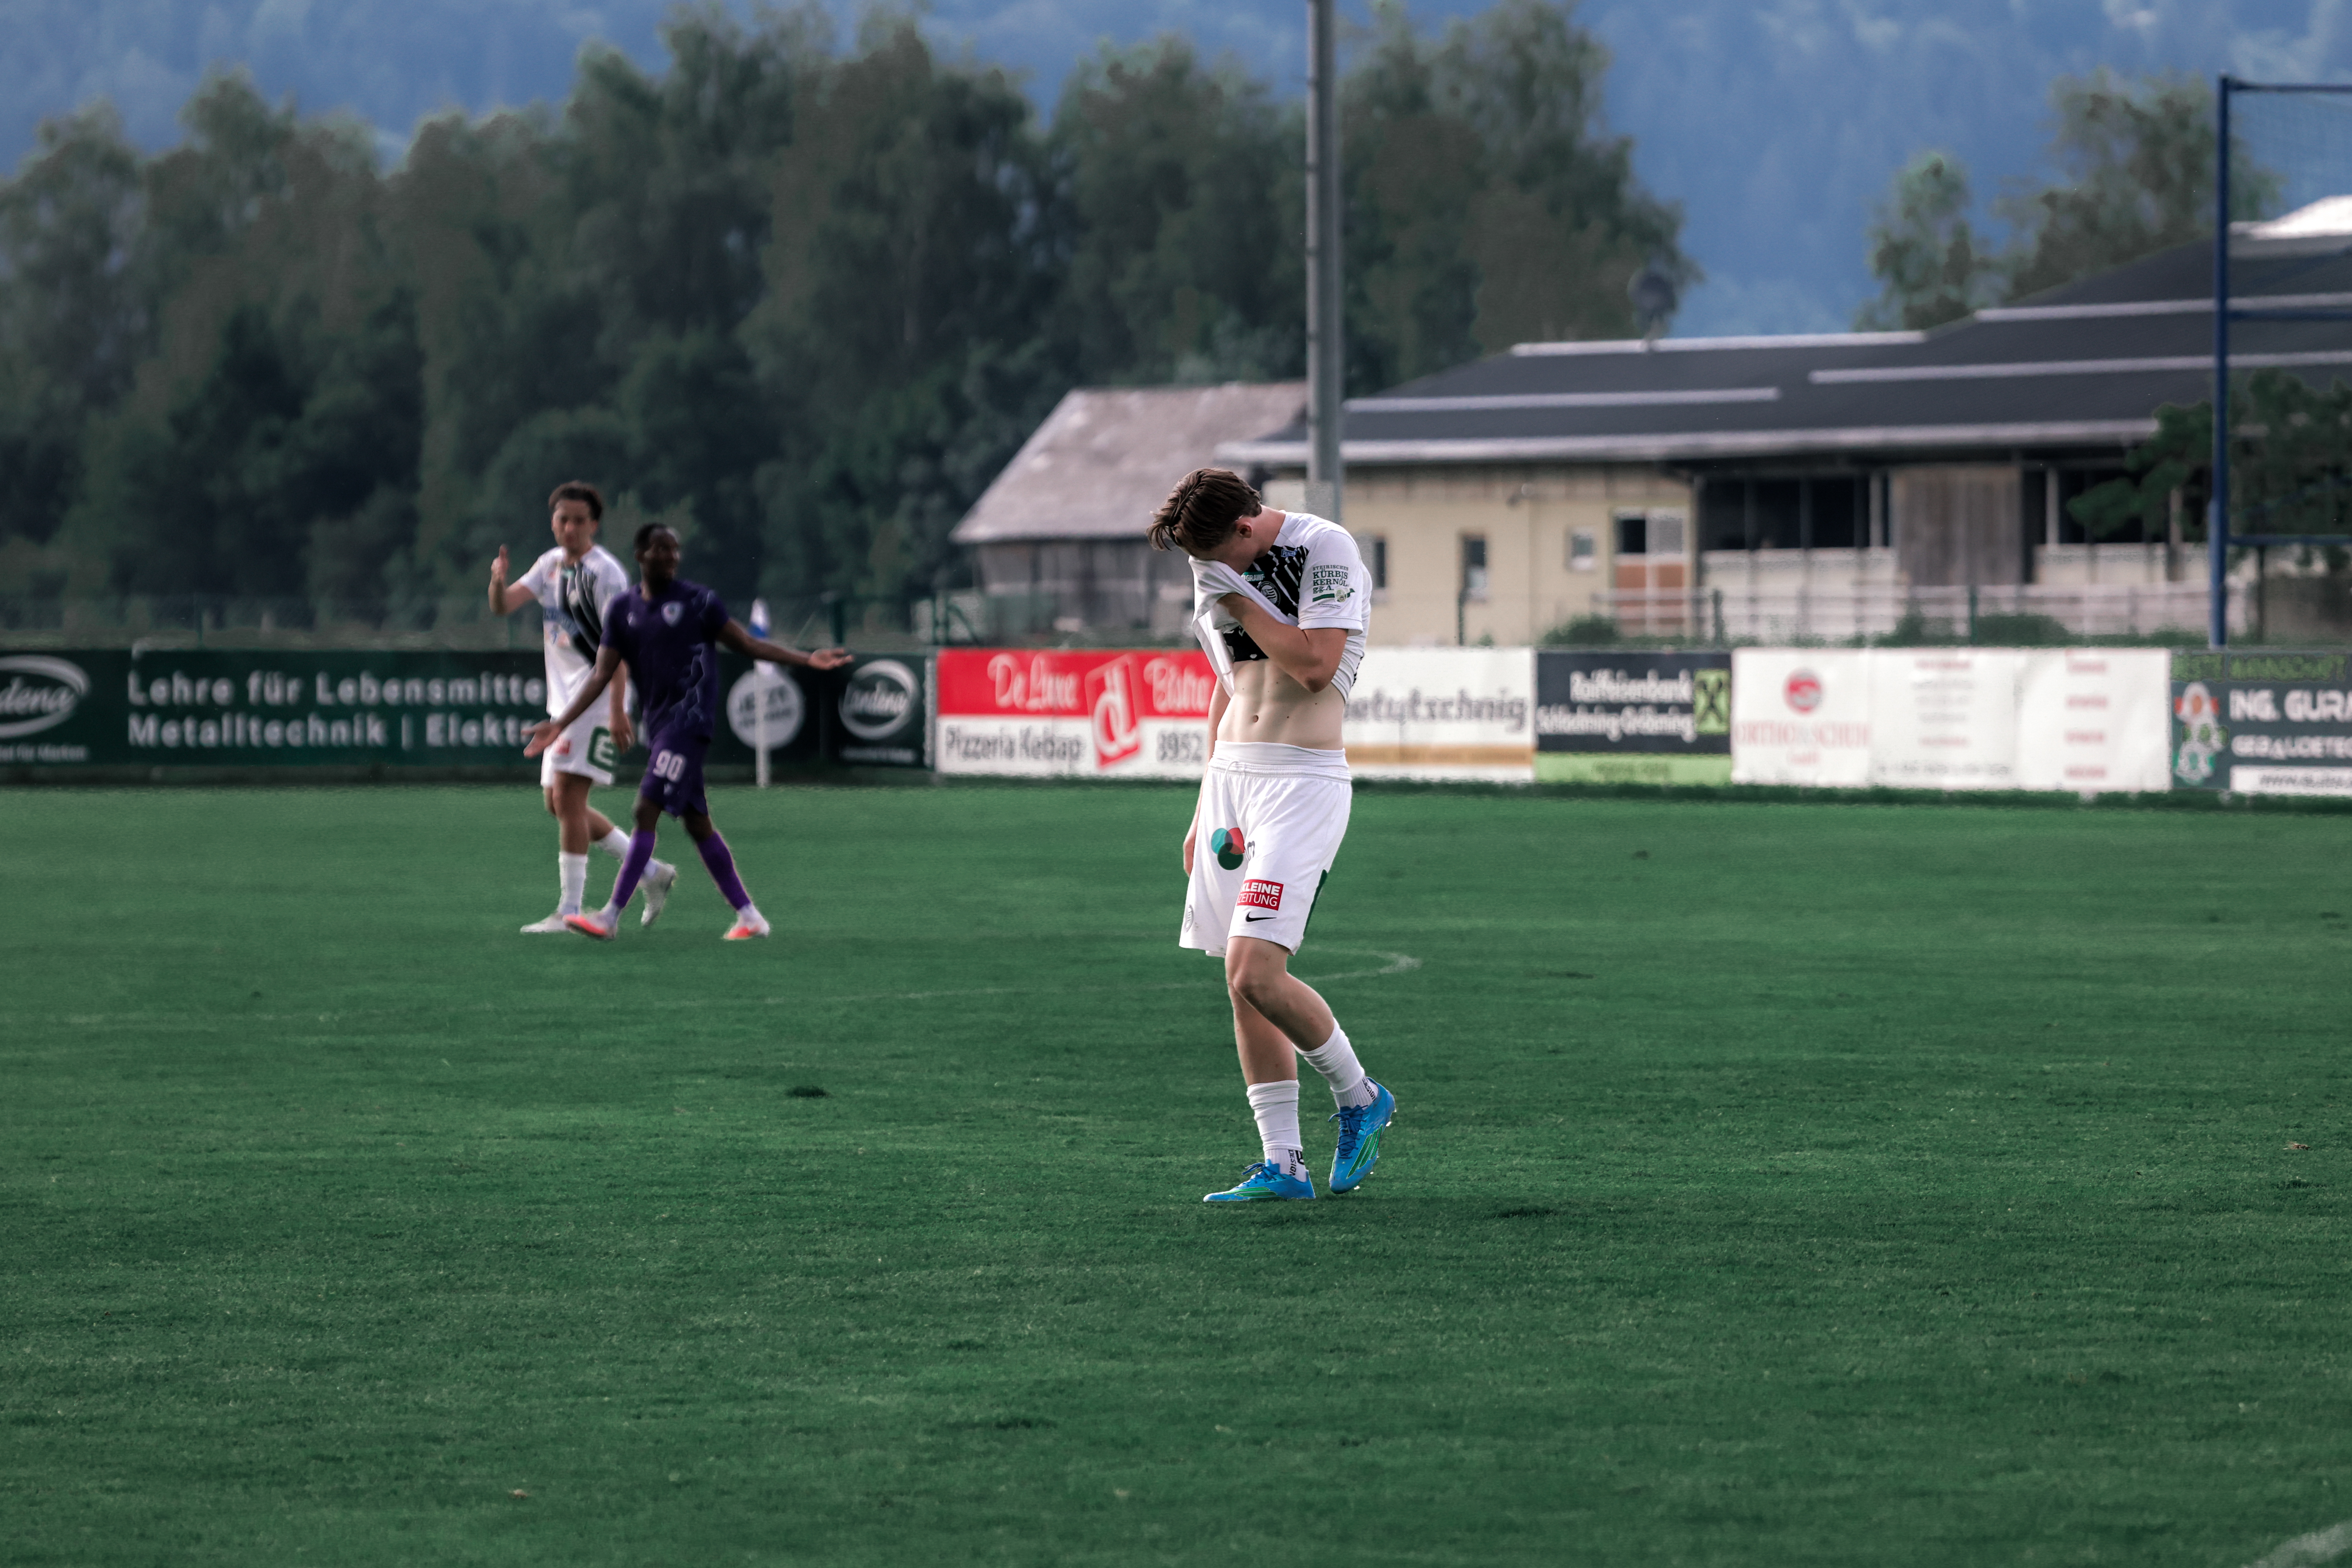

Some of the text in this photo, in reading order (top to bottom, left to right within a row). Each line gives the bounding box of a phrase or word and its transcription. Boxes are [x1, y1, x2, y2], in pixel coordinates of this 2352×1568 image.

[1312, 569, 1348, 579] KÜRBIS
[1312, 578, 1348, 587] KERNÖL
[1313, 585, 1334, 594] g.g.A.
[128, 670, 234, 706] Lehre
[247, 670, 302, 706] für
[128, 712, 387, 748] Metalltechnik
[652, 749, 685, 782] 90
[1241, 882, 1281, 896] KLEINE
[1237, 893, 1278, 907] ZEITUNG
